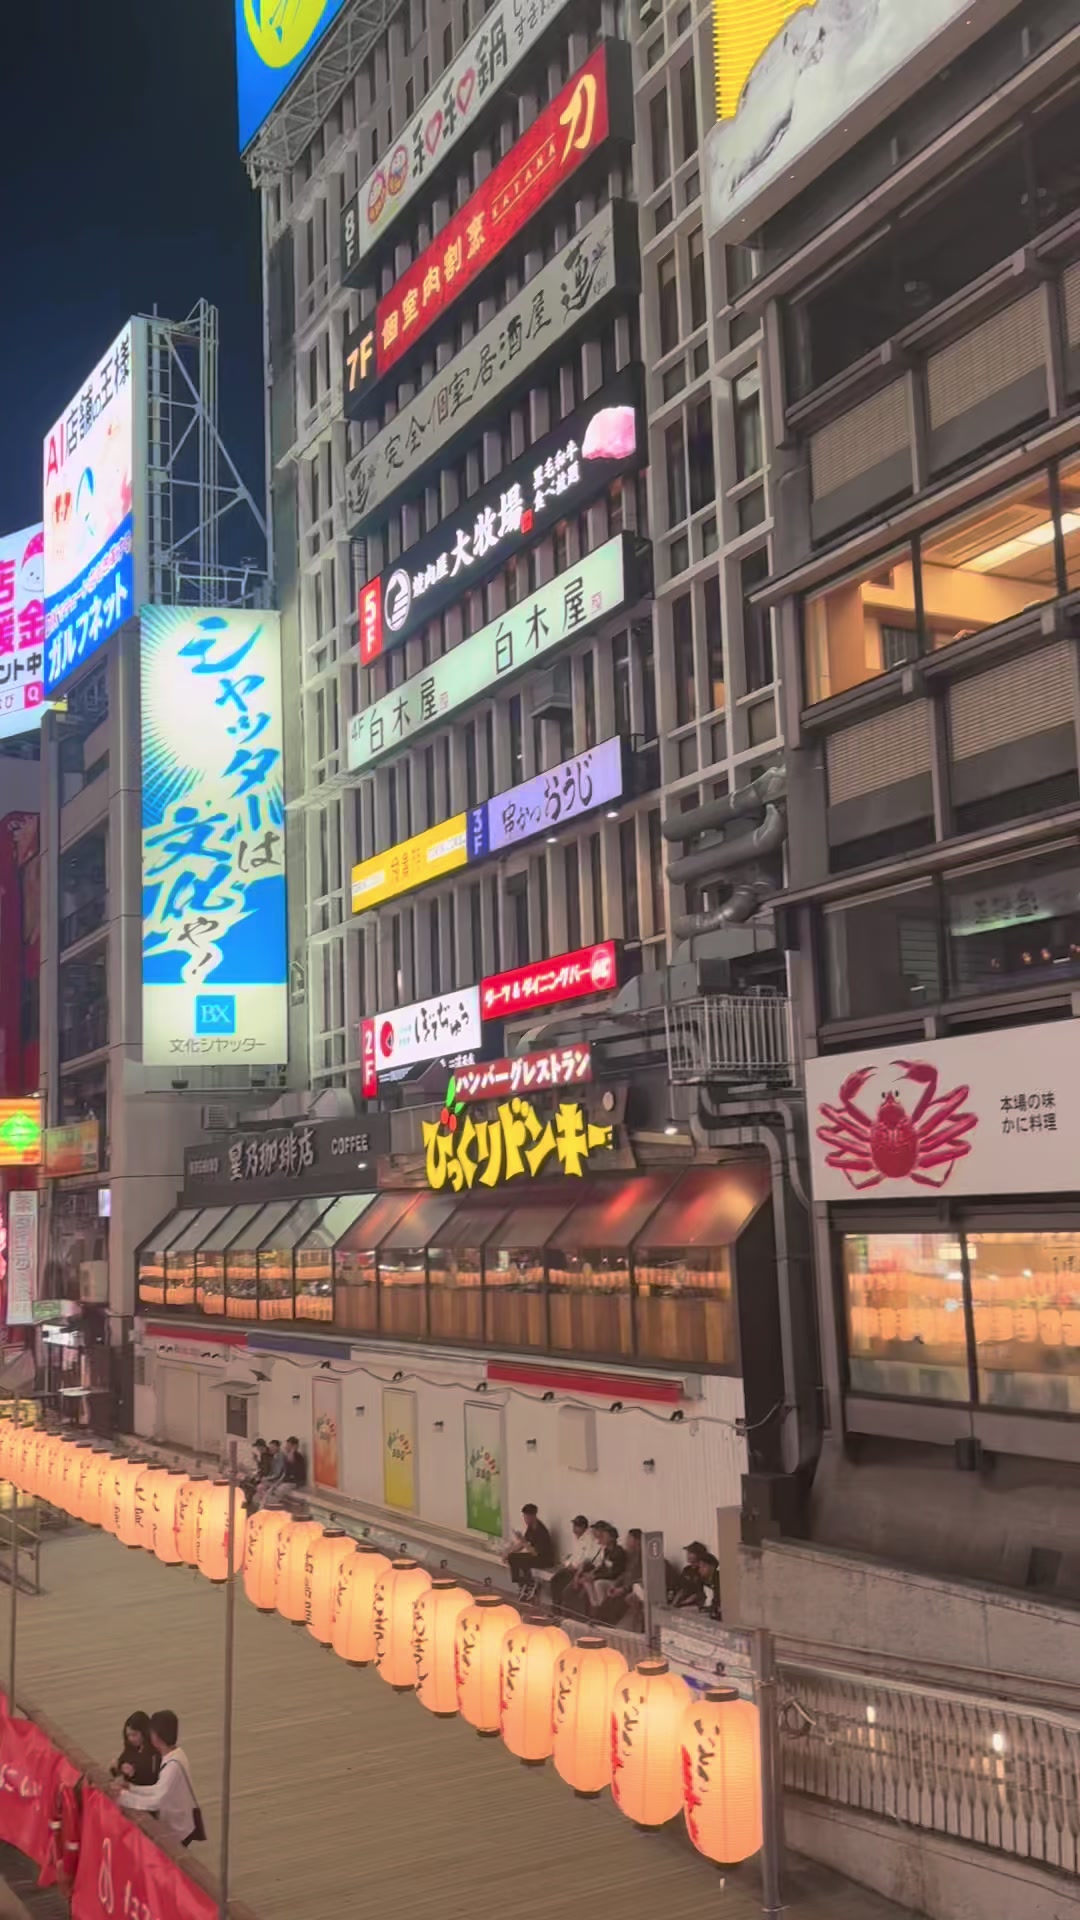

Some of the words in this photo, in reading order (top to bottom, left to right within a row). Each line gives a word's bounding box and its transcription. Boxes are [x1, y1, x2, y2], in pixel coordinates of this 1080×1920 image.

[344, 213, 355, 269] 8F
[346, 330, 374, 392] 7F
[364, 589, 378, 654] 5F
[495, 576, 588, 676] 白木屋
[369, 676, 438, 754] 白木屋
[201, 1004, 232, 1024] BX
[364, 1029, 374, 1087] 2F
[455, 1049, 591, 1095] ハンバーグレストラン
[1000, 1092, 1056, 1113] 本場の味
[1001, 1113, 1057, 1134] かに料理
[331, 1132, 369, 1156] COFFEE
[421, 1096, 615, 1192] びっくりドンキー
